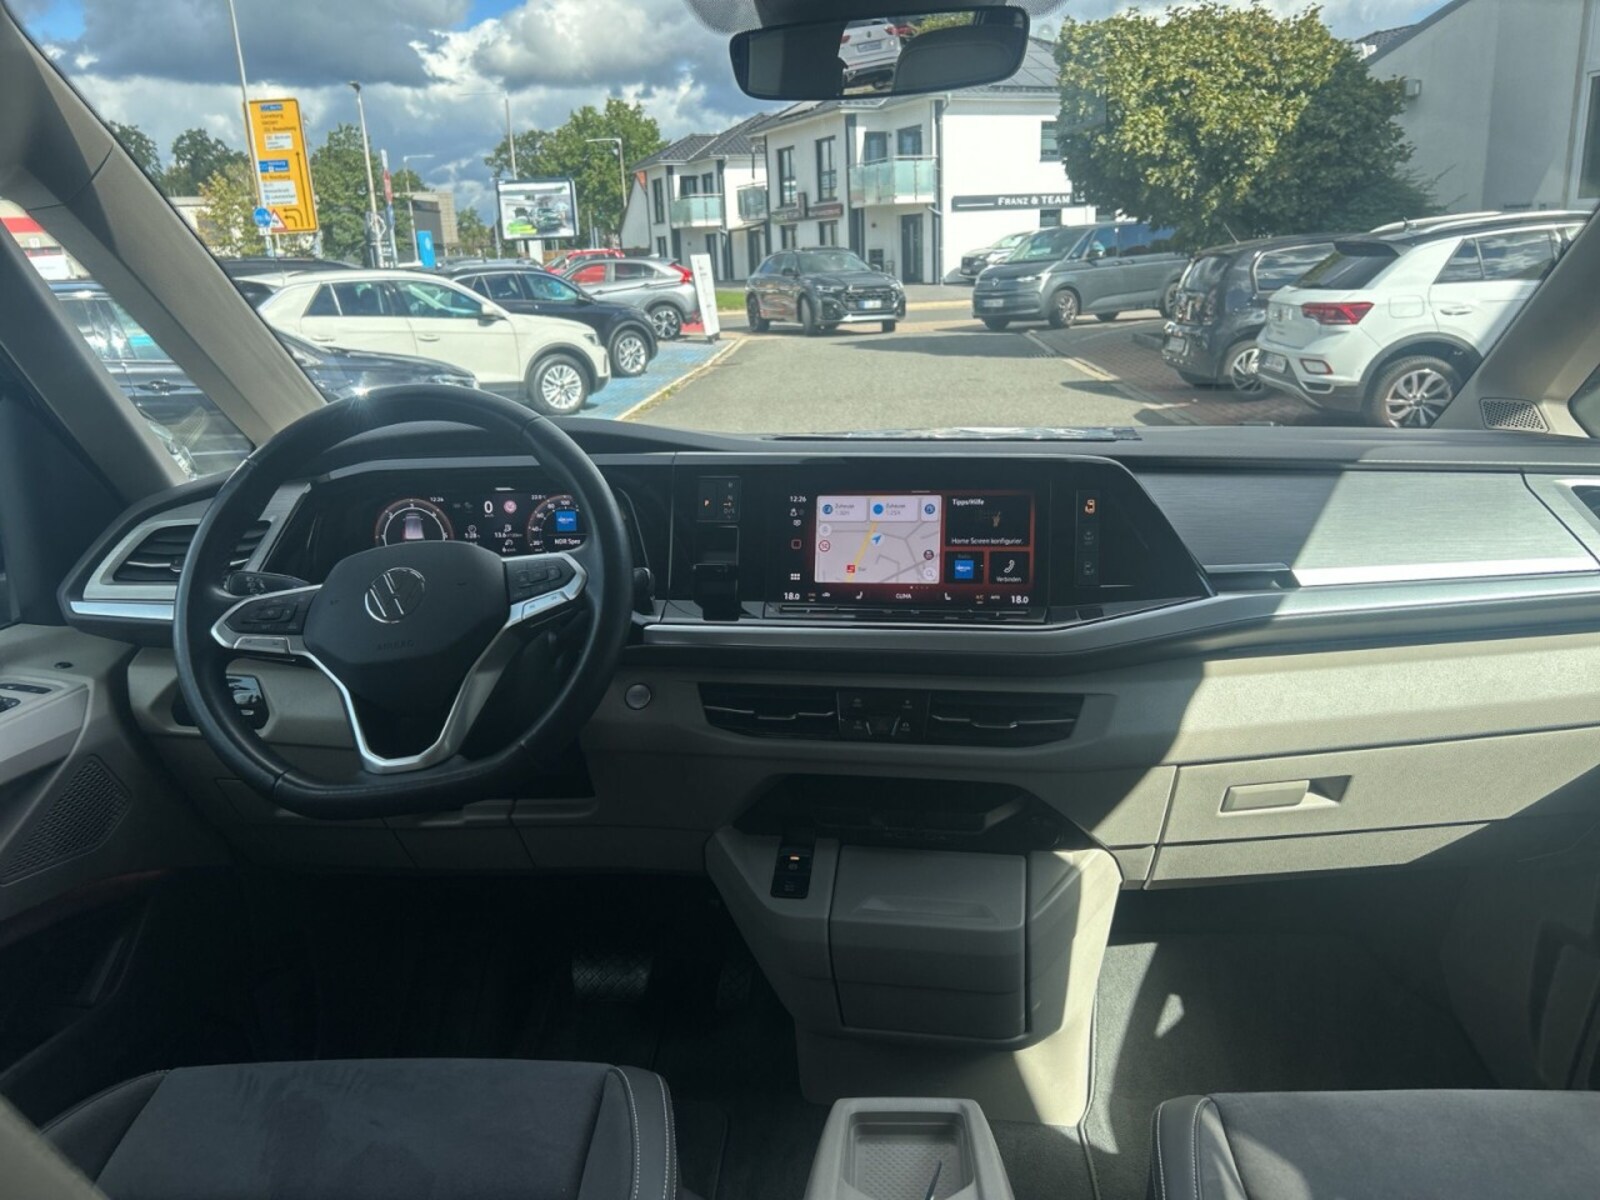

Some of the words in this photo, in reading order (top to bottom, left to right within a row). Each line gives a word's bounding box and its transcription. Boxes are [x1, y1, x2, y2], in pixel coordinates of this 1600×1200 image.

[997, 197, 1029, 206] FRANZ
[1030, 196, 1039, 205] &
[1041, 195, 1071, 205] TEAM
[484, 500, 494, 514] 0
[784, 592, 800, 600] 18.0
[1011, 595, 1029, 604] 18.0
